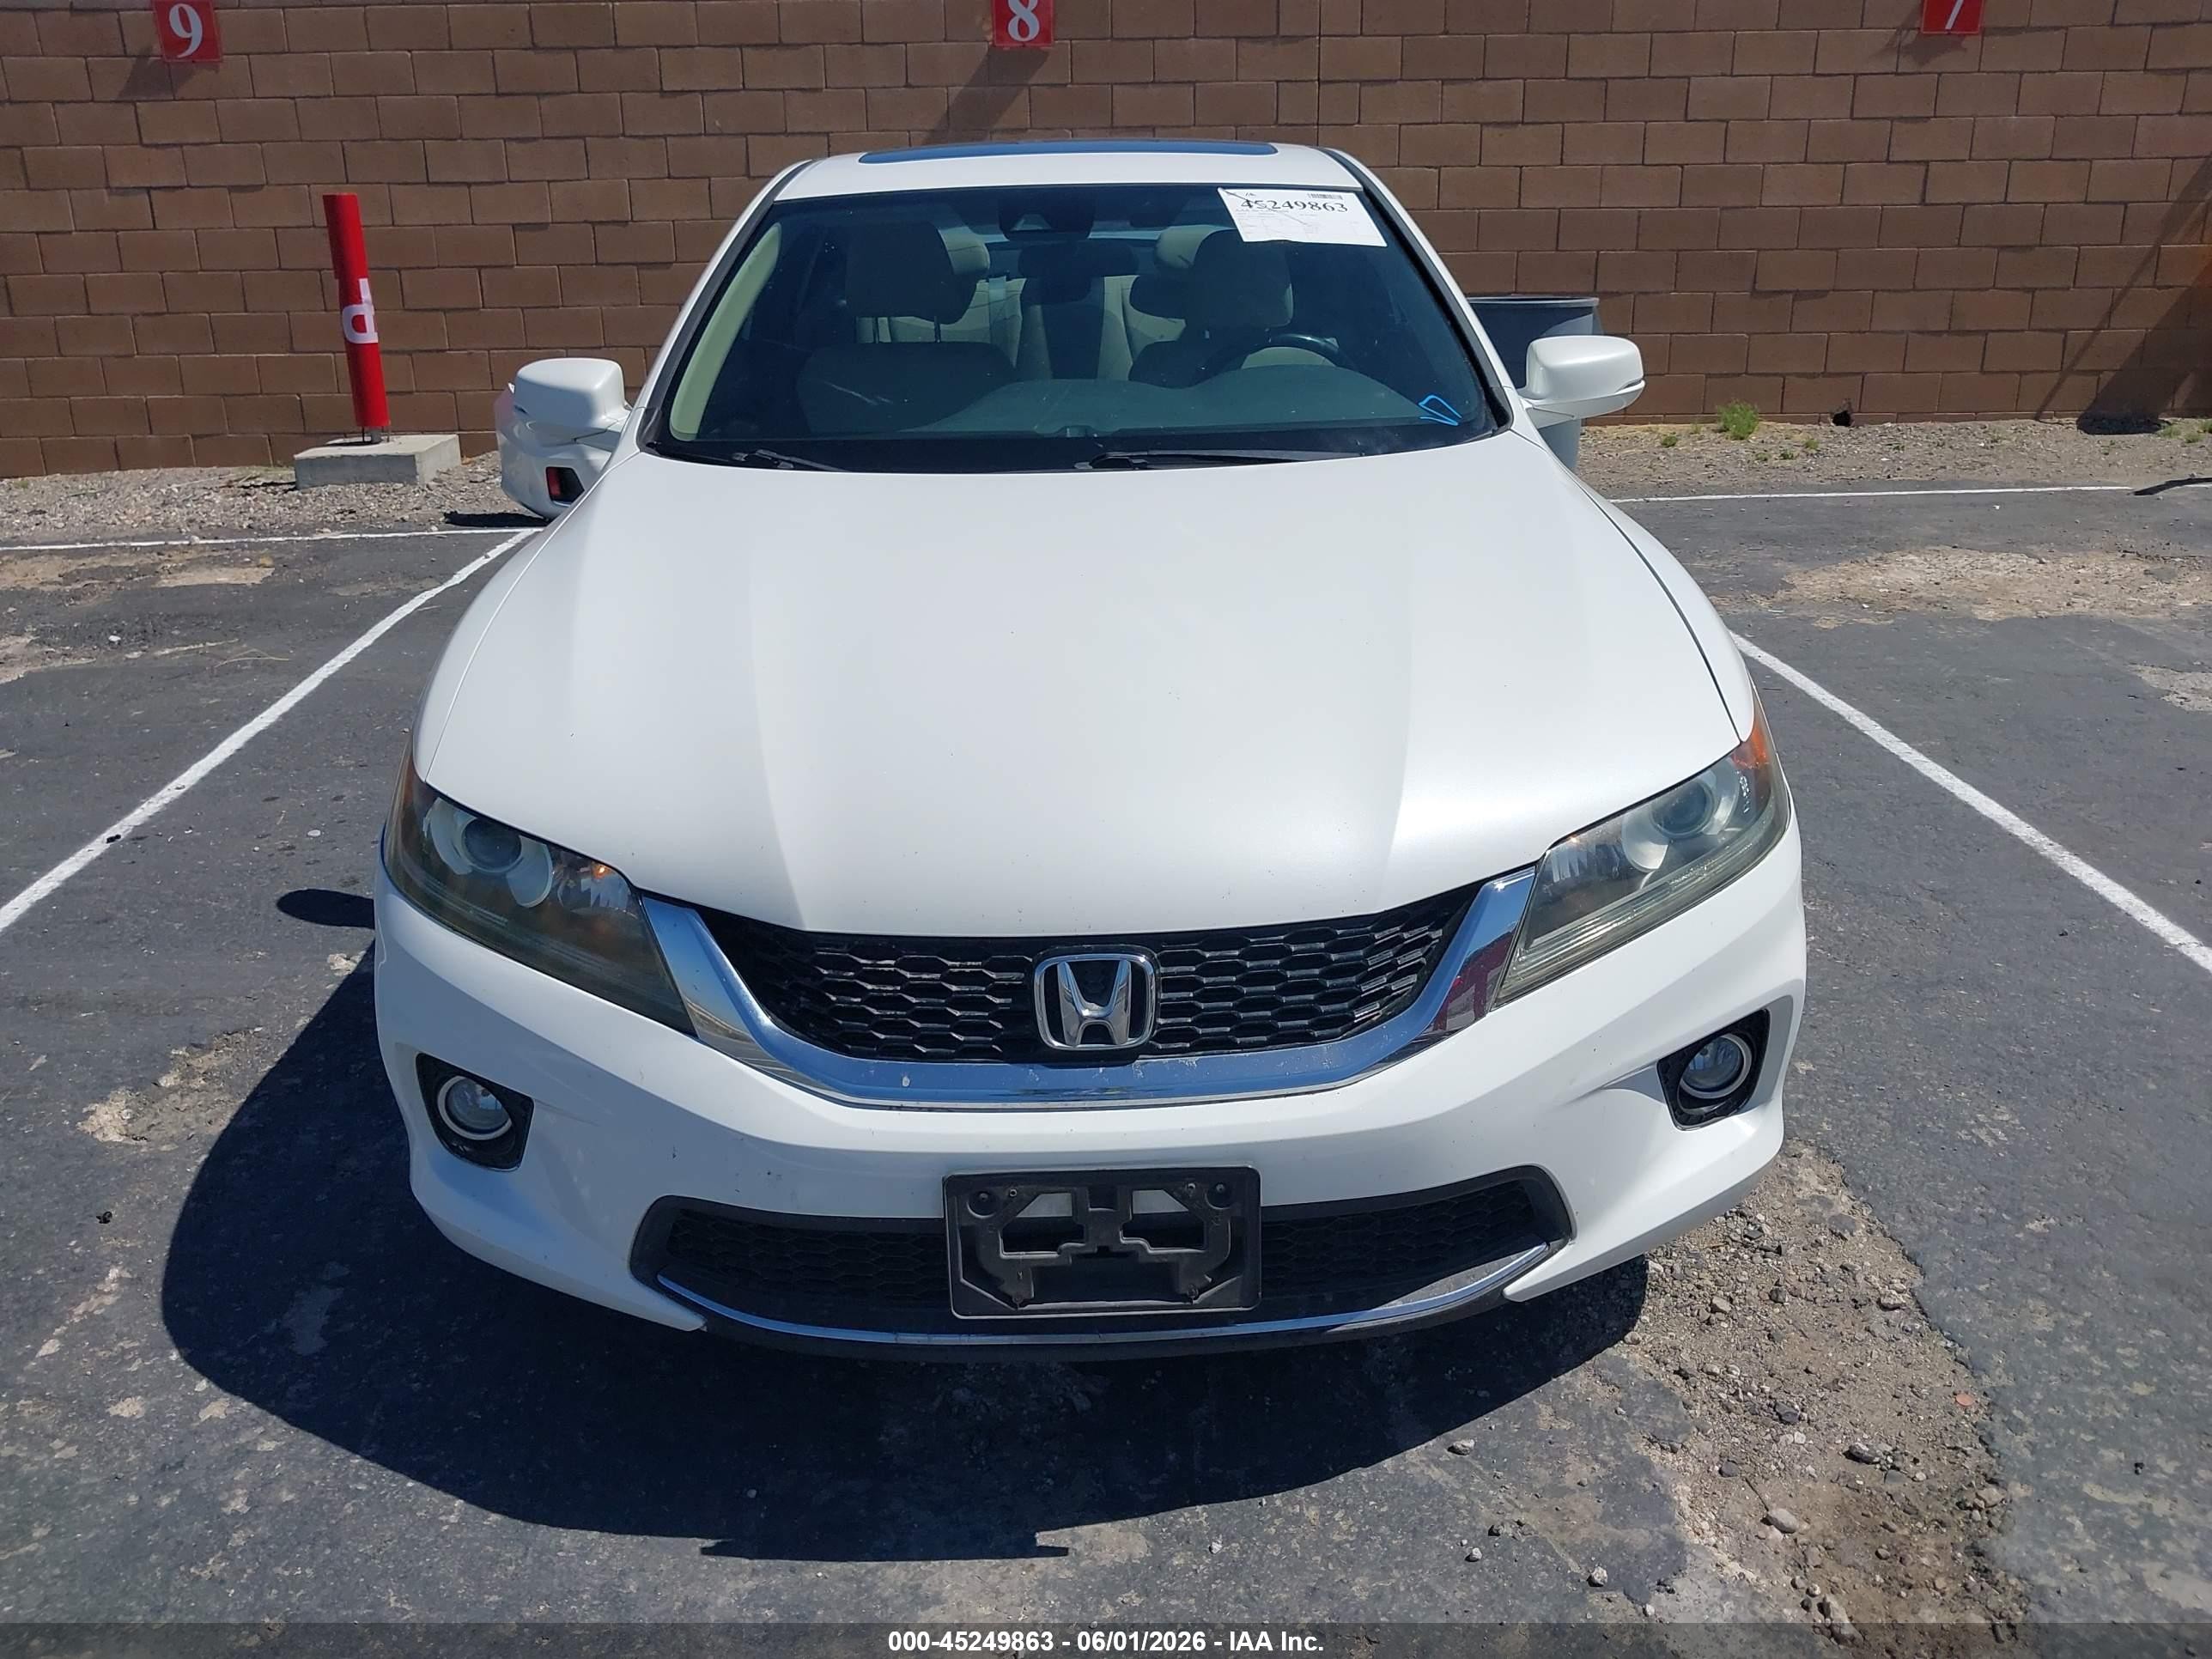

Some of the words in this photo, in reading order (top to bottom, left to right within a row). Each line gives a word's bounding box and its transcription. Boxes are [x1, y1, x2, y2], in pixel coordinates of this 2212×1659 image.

[168, 3, 203, 58] 9
[1007, 0, 1039, 41] 8
[1241, 199, 1348, 213] 45249863
